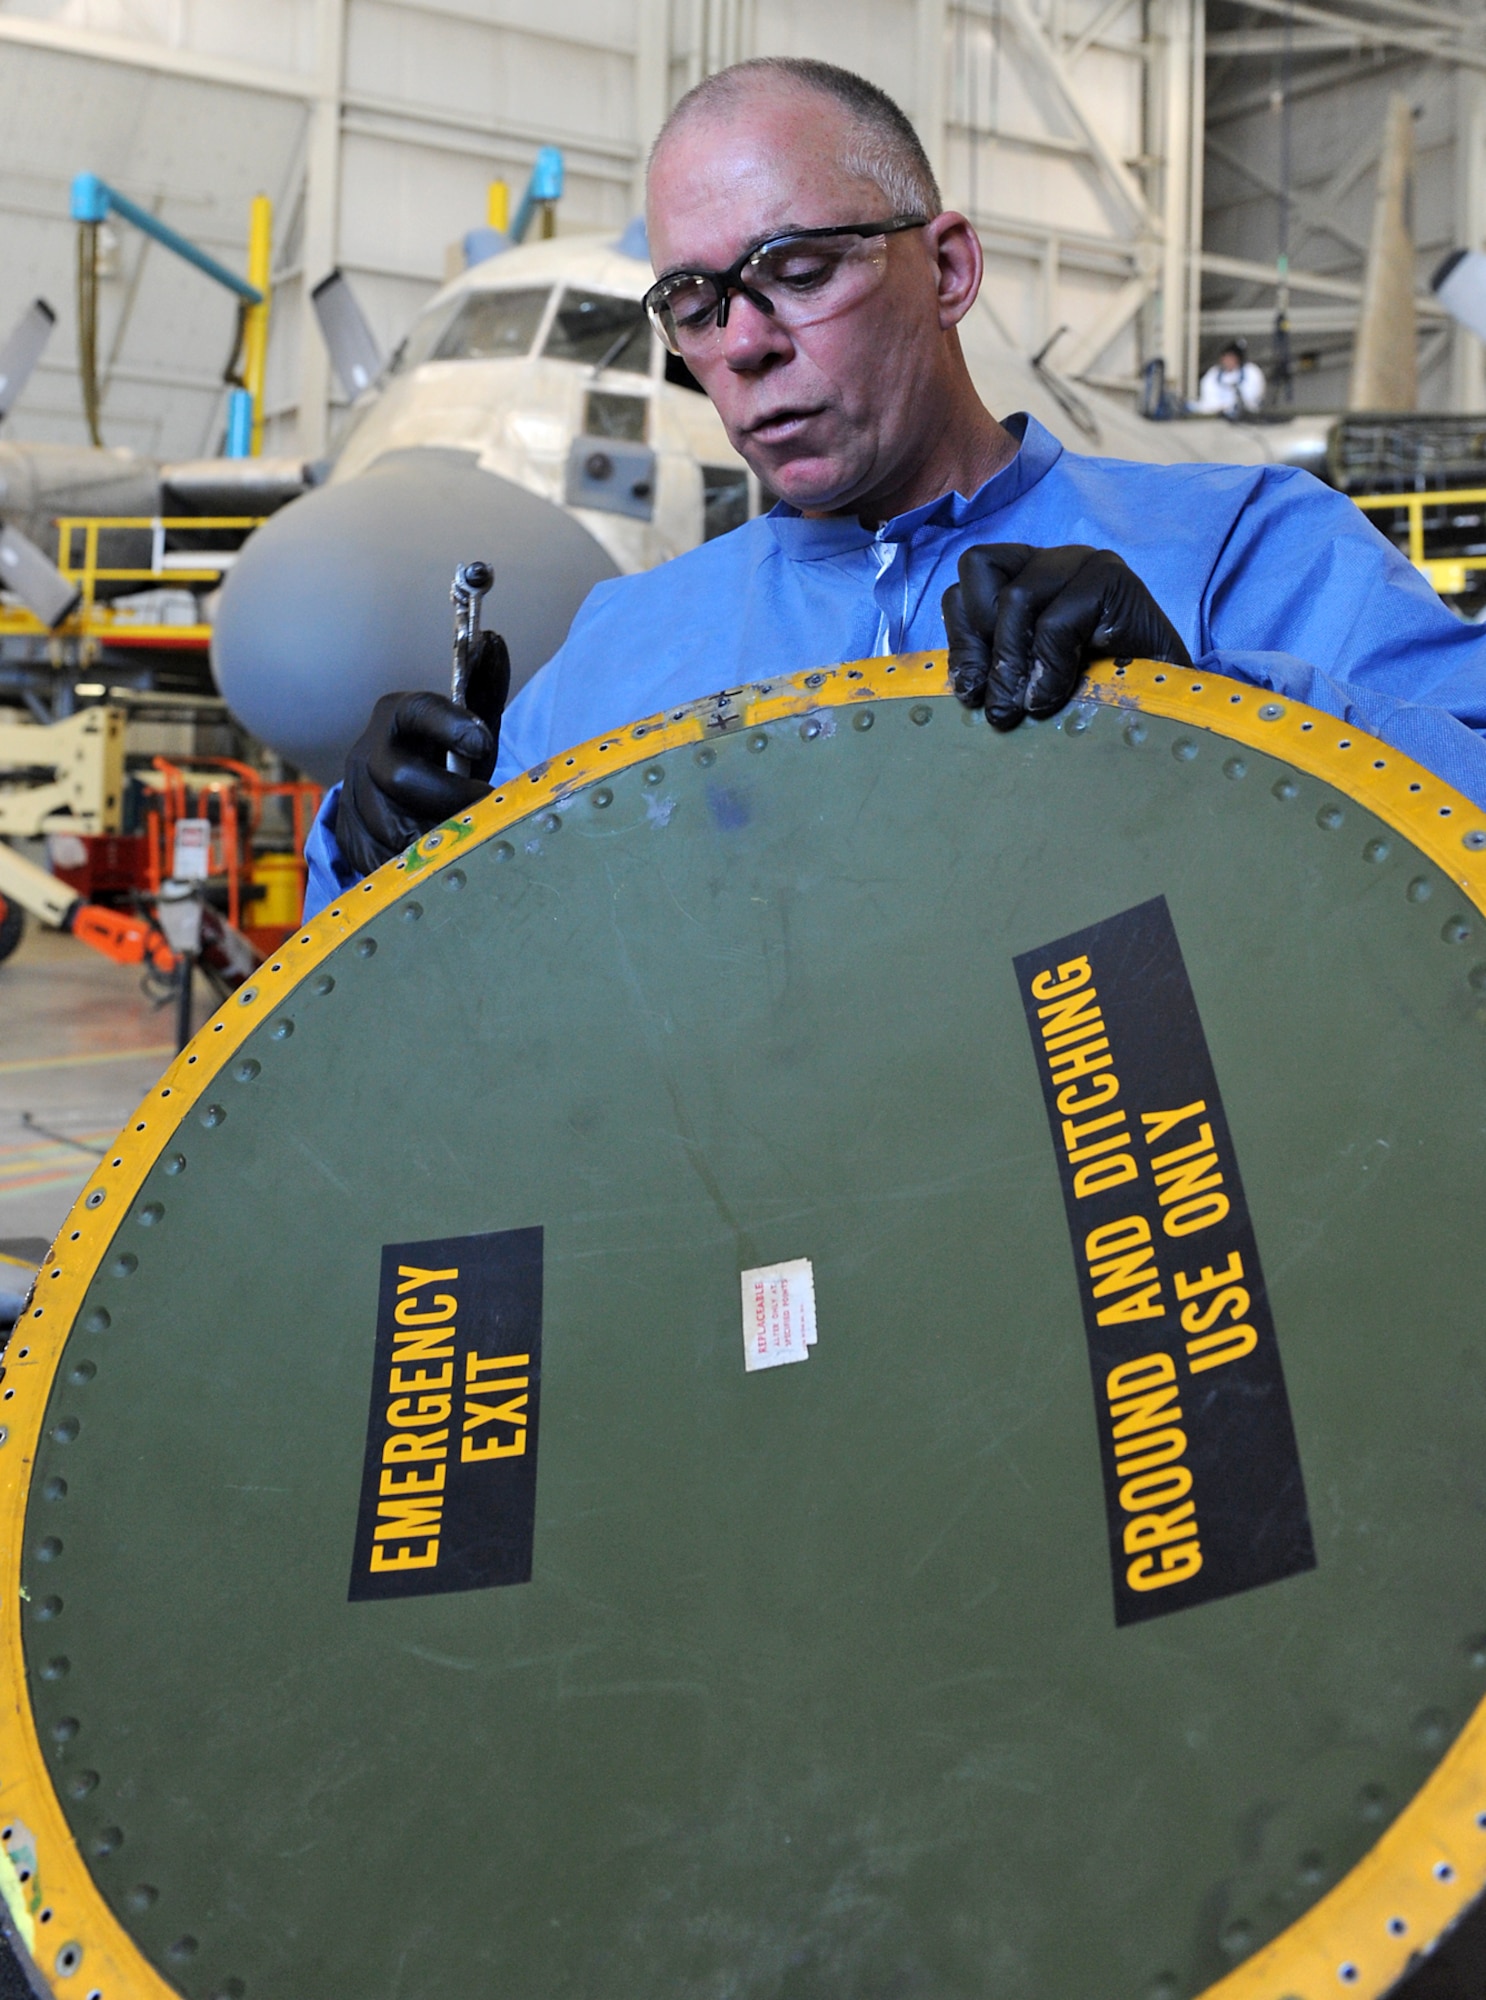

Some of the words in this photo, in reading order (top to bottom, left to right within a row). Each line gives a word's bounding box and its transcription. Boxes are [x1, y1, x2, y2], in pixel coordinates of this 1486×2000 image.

[1031, 954, 1139, 1199] DITCHING
[1141, 1099, 1231, 1238] ONLY
[754, 1281, 767, 1354] REPLACEABLE
[1085, 1215, 1166, 1327] AND
[1174, 1250, 1259, 1375] USE
[370, 1264, 459, 1573] EMERGENCY
[461, 1350, 530, 1464] EXIT
[1107, 1353, 1203, 1592] GROUND
